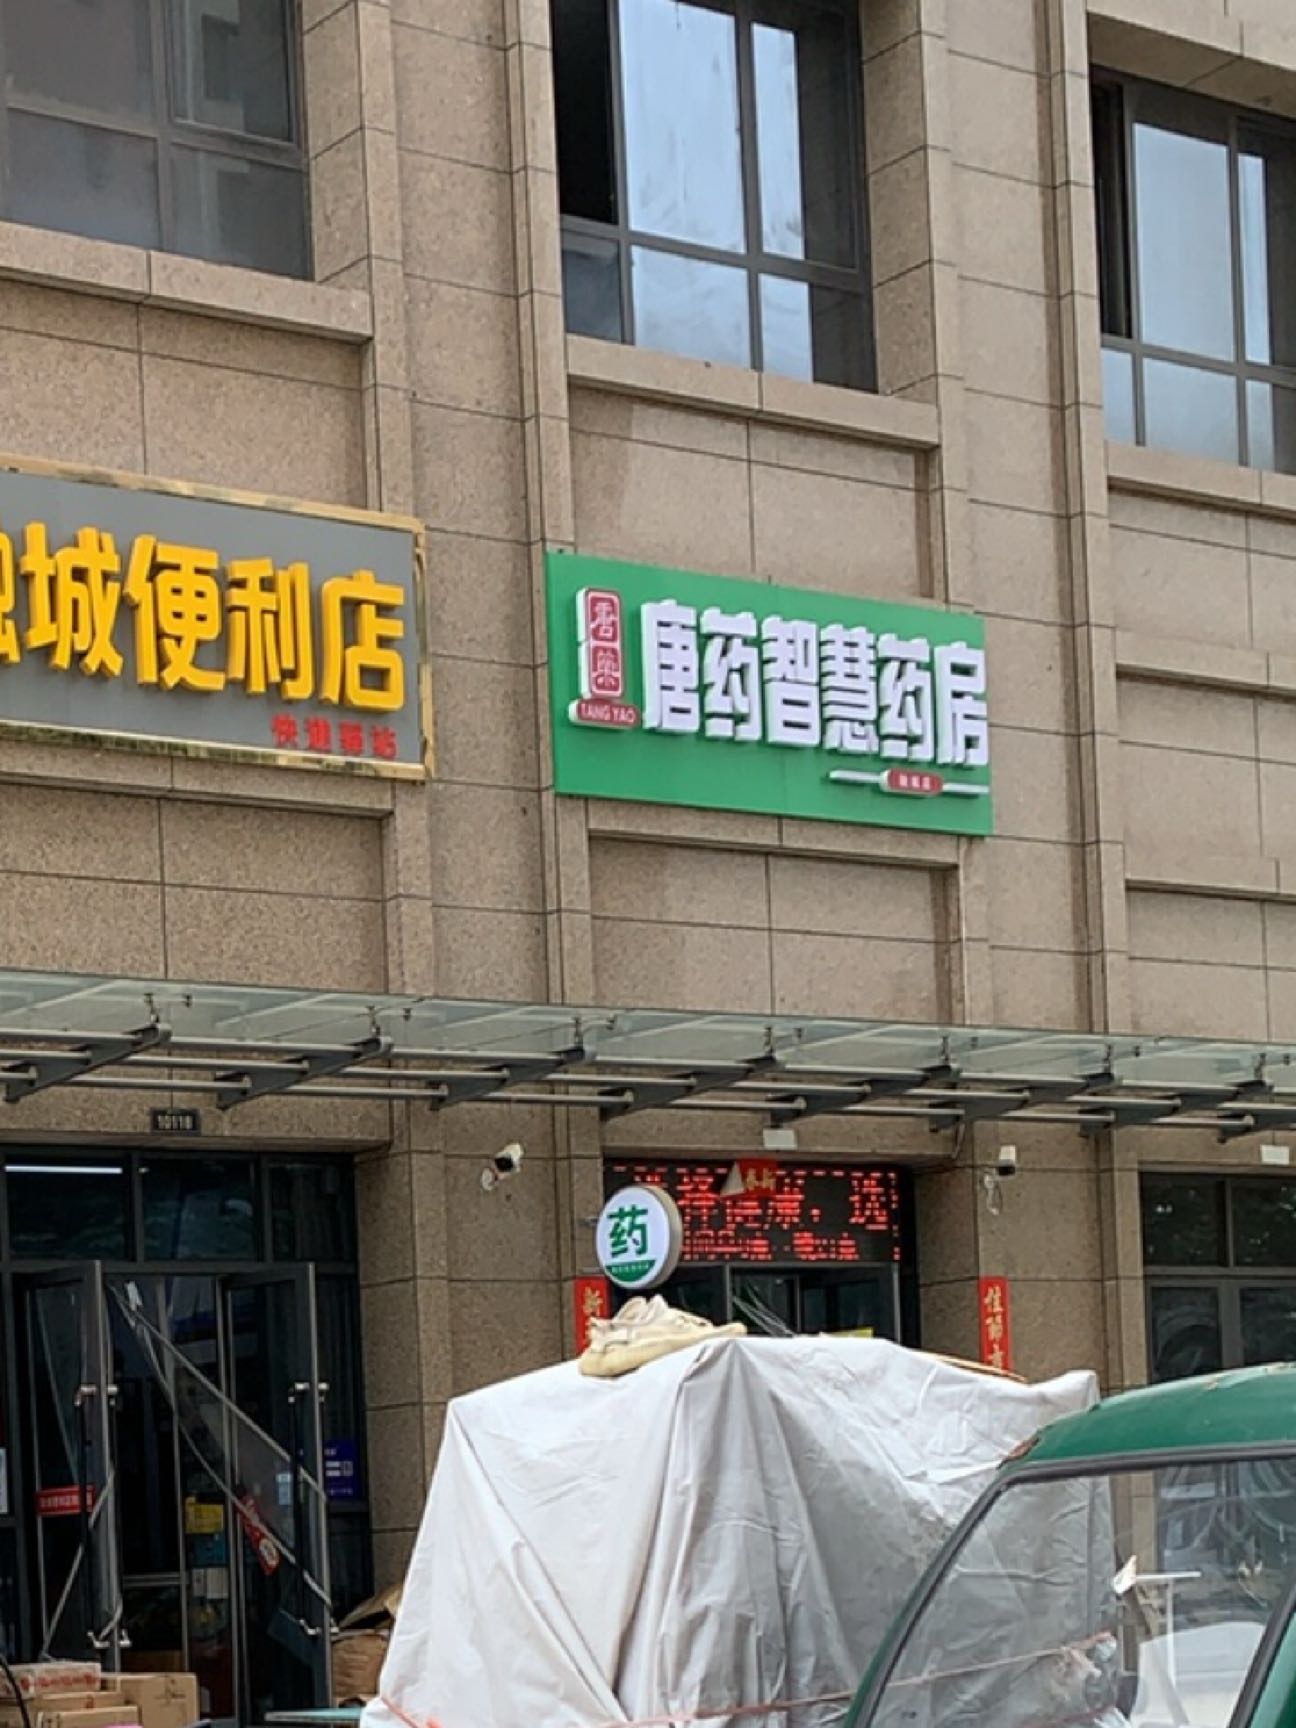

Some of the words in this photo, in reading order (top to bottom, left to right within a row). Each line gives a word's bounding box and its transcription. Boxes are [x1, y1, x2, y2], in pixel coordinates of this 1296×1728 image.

[640, 598, 990, 767] 唐药智慧药房
[612, 706, 637, 723] YAO
[607, 1204, 649, 1258] 药
